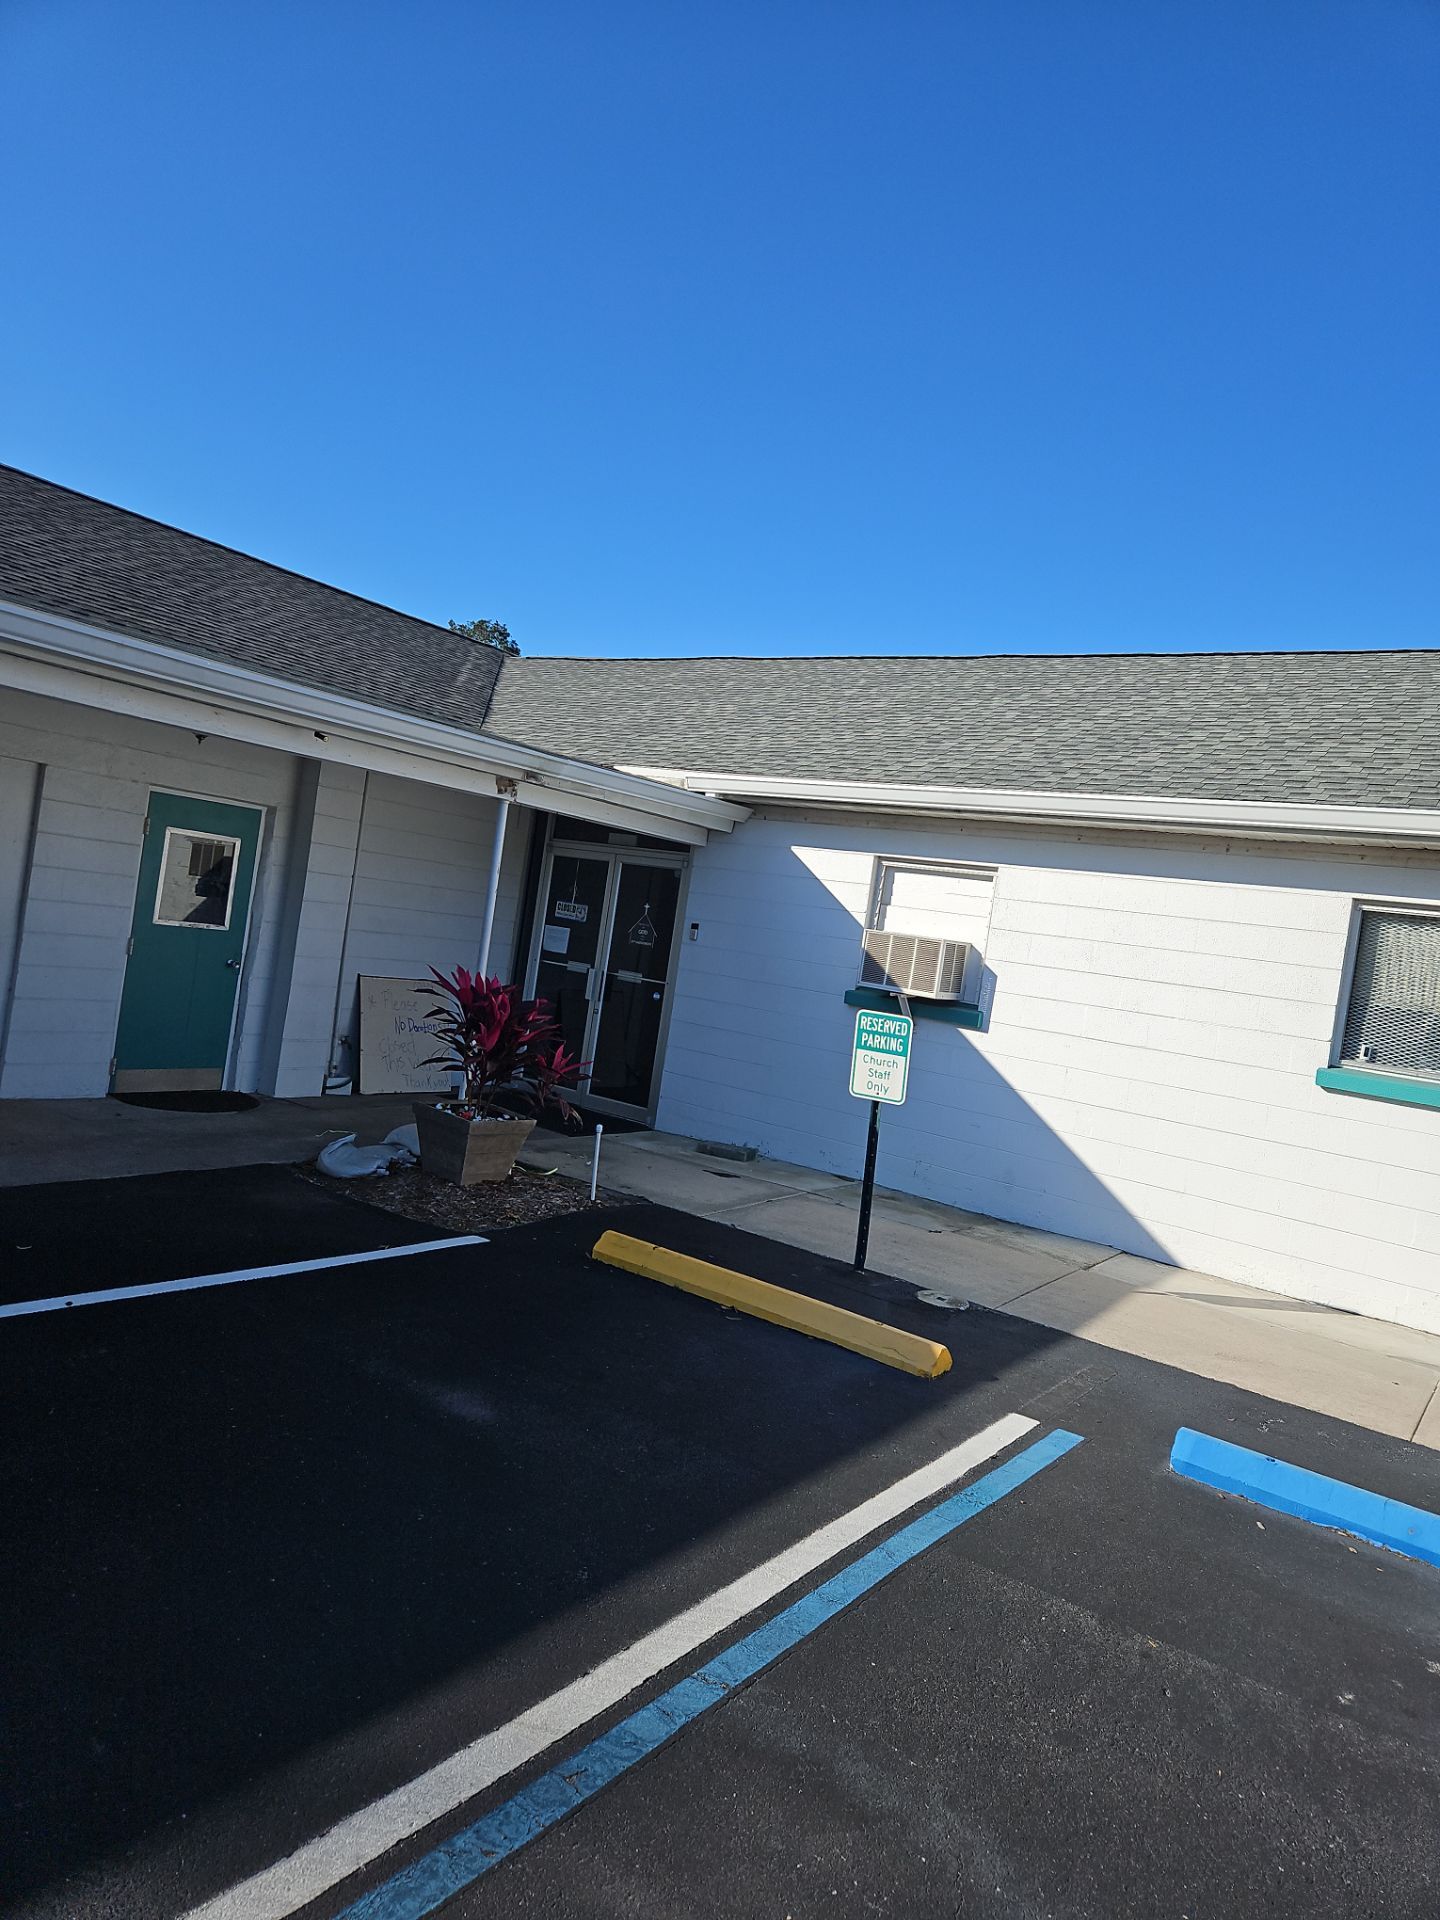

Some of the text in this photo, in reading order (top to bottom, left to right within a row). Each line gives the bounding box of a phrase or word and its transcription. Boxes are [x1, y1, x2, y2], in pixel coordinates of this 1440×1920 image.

[395, 1016, 406, 1035] No
[860, 1015, 908, 1036] RESERVED
[861, 1032, 903, 1052] PARKING
[863, 1054, 898, 1069] Church
[868, 1067, 891, 1080] Staff
[866, 1081, 890, 1095] Only
